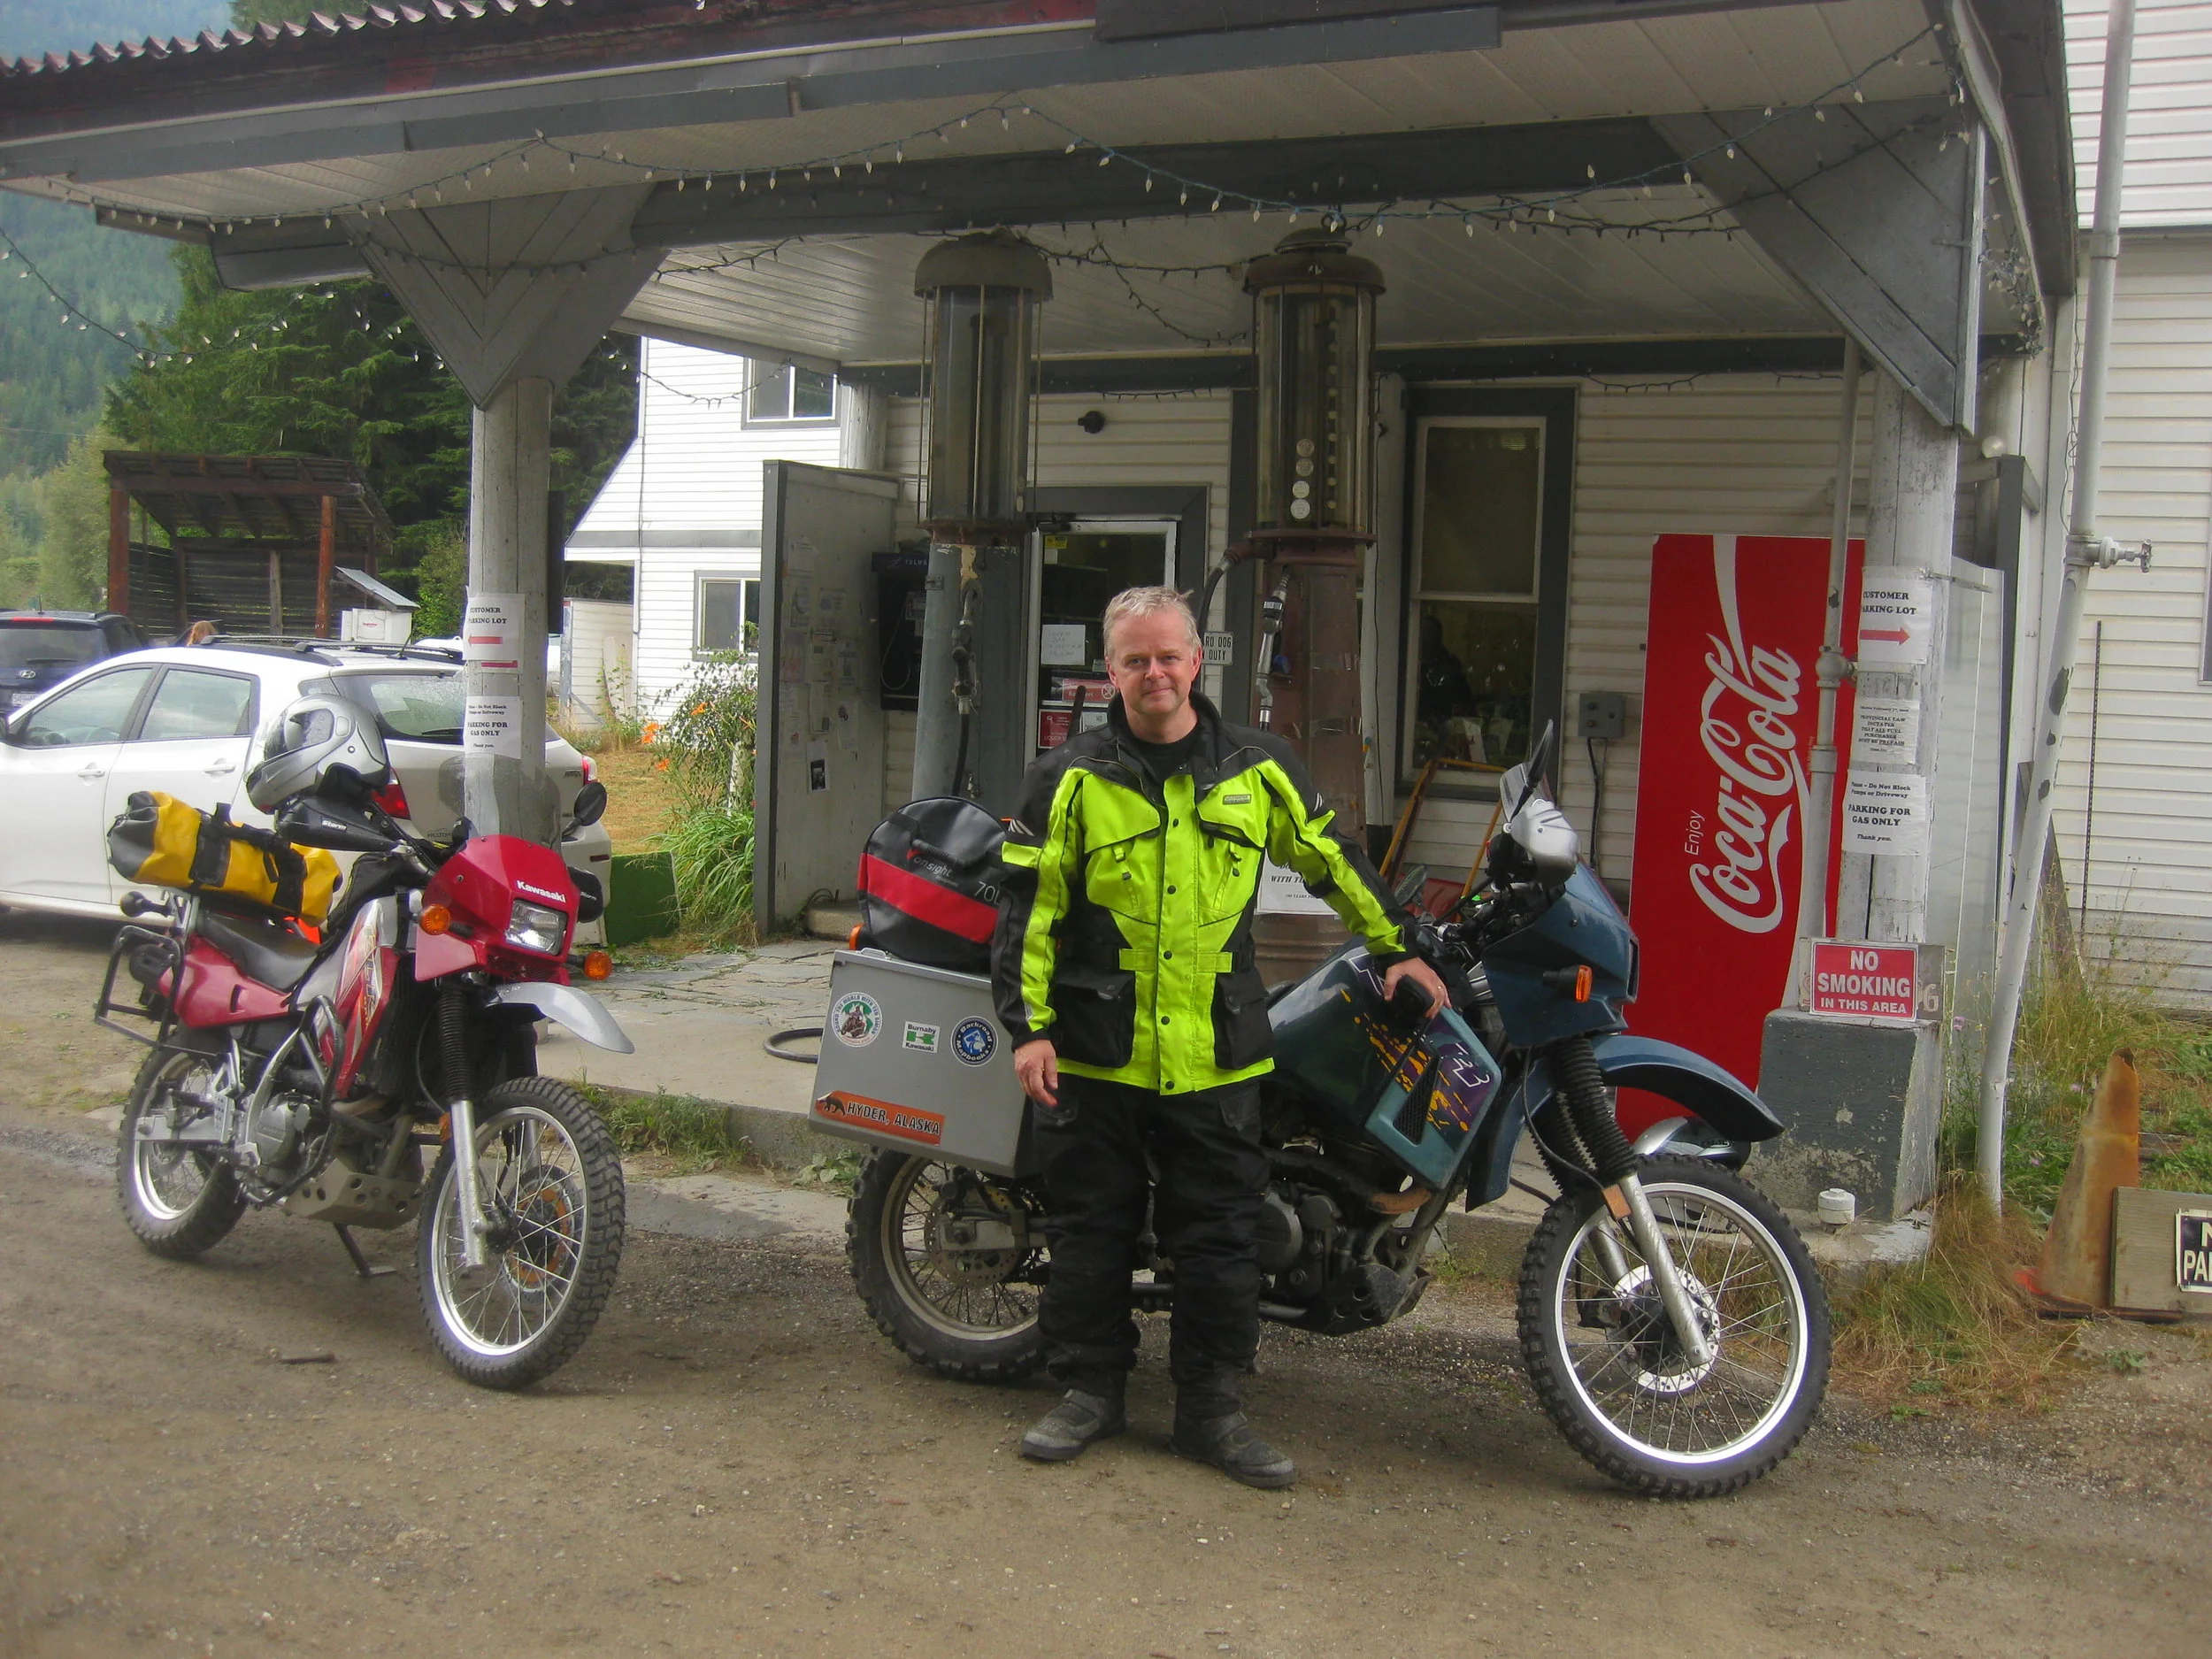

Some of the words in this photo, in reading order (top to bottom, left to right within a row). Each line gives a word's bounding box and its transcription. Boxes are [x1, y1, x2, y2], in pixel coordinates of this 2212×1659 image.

[1209, 649, 1226, 660] DUTY
[1689, 633, 1801, 934] Coca-Cola
[1848, 804, 1887, 814] PARKING
[321, 819, 347, 831] Storm
[1684, 810, 1706, 856] Enjoy
[913, 856, 954, 878] onsight
[516, 879, 566, 903] Kawasaki
[973, 880, 1001, 906] 70L
[1849, 949, 1879, 972] NO
[1816, 972, 1911, 998] SMOKING
[842, 995, 860, 1004] WORLD
[861, 996, 873, 1007] WITH
[1820, 997, 1834, 1009] IN
[1838, 998, 1868, 1011] THIS
[1871, 1001, 1908, 1014] AREA
[907, 1024, 936, 1034] Burnaby
[959, 1021, 994, 1042] Backroad
[905, 1042, 934, 1052] Kawasaki
[956, 1039, 990, 1061] Mapbooks
[847, 1101, 890, 1126] HYDER,
[894, 1113, 941, 1136] ALASKA
[2201, 1222, 2212, 1247] N
[2184, 1250, 2212, 1281] PA
